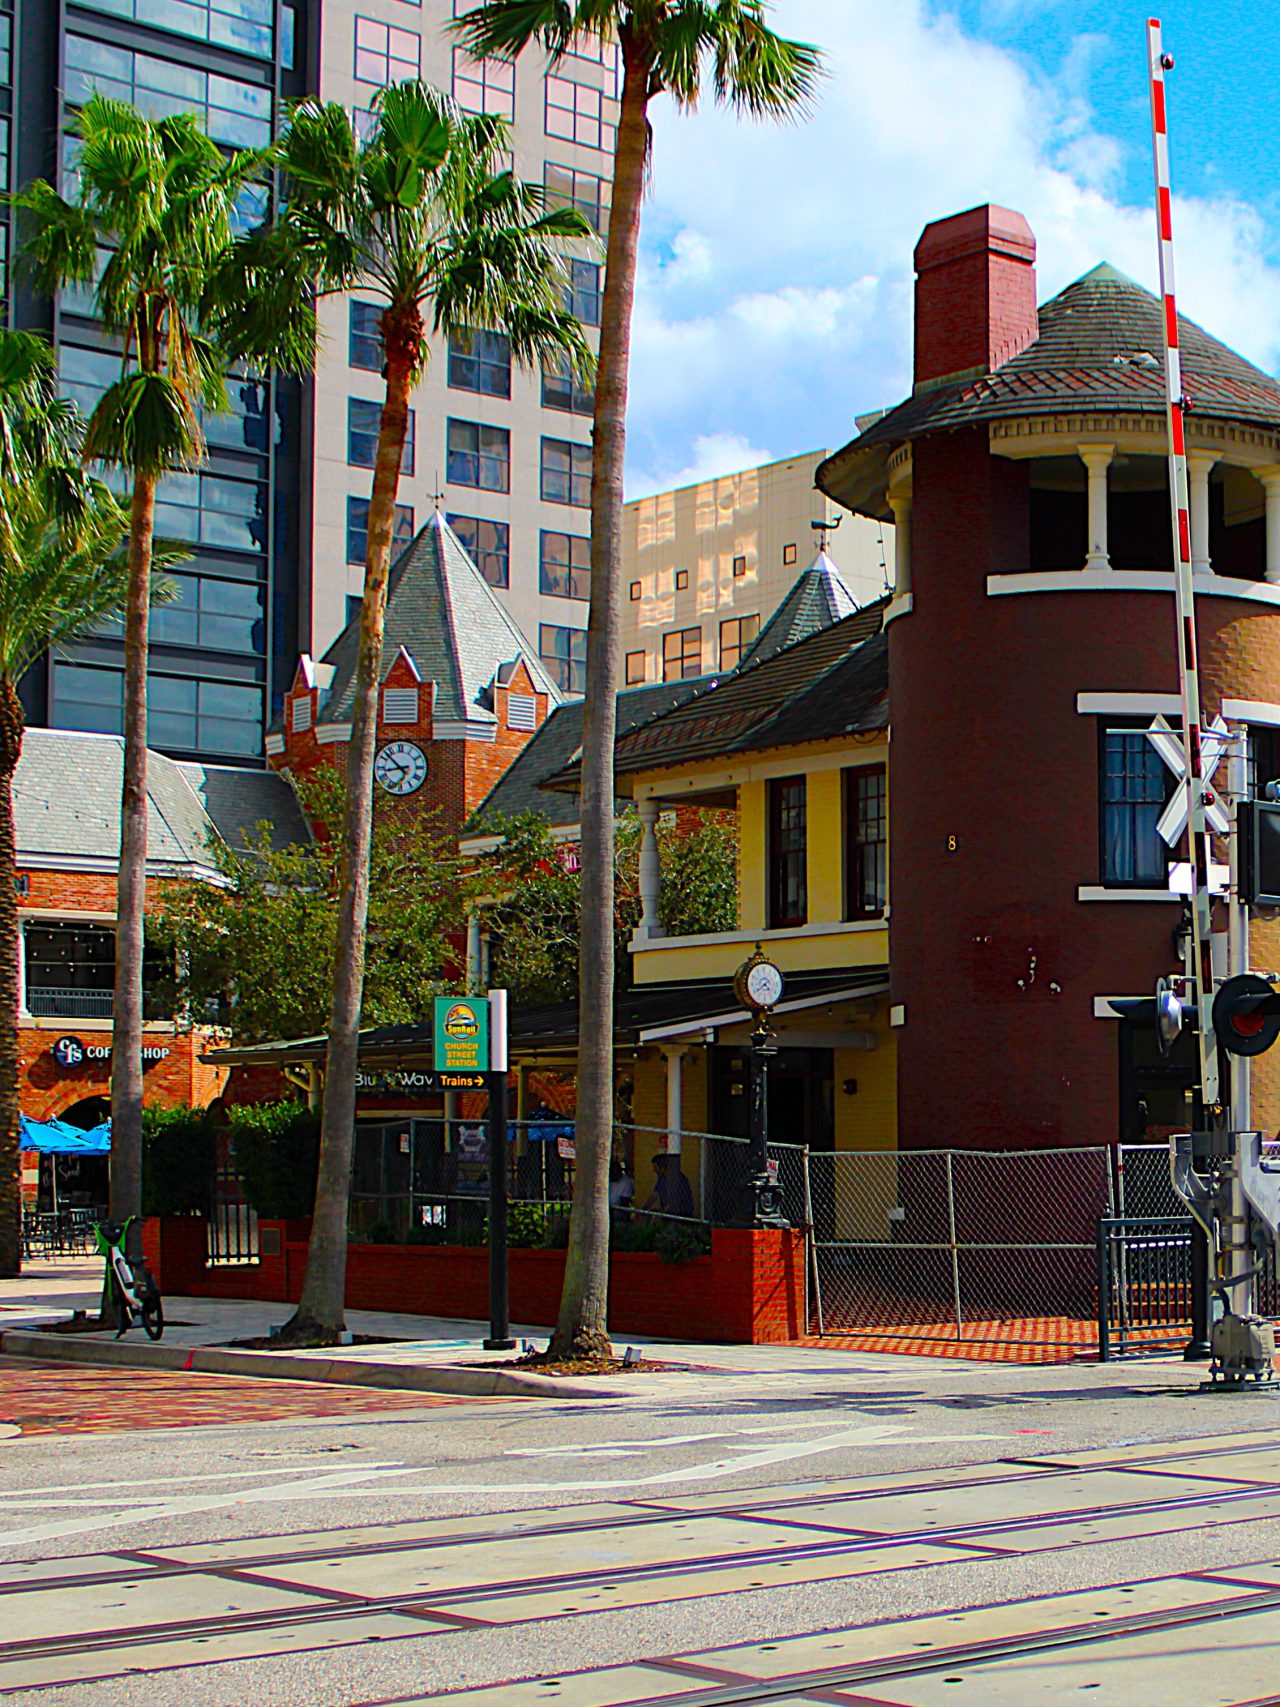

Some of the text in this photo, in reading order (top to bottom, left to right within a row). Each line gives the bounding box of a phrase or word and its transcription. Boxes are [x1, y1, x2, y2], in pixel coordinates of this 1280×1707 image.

[948, 835, 956, 850] 8
[447, 1025, 476, 1033] SunRail
[141, 1047, 170, 1059] HOP
[440, 1075, 473, 1087] Trains
